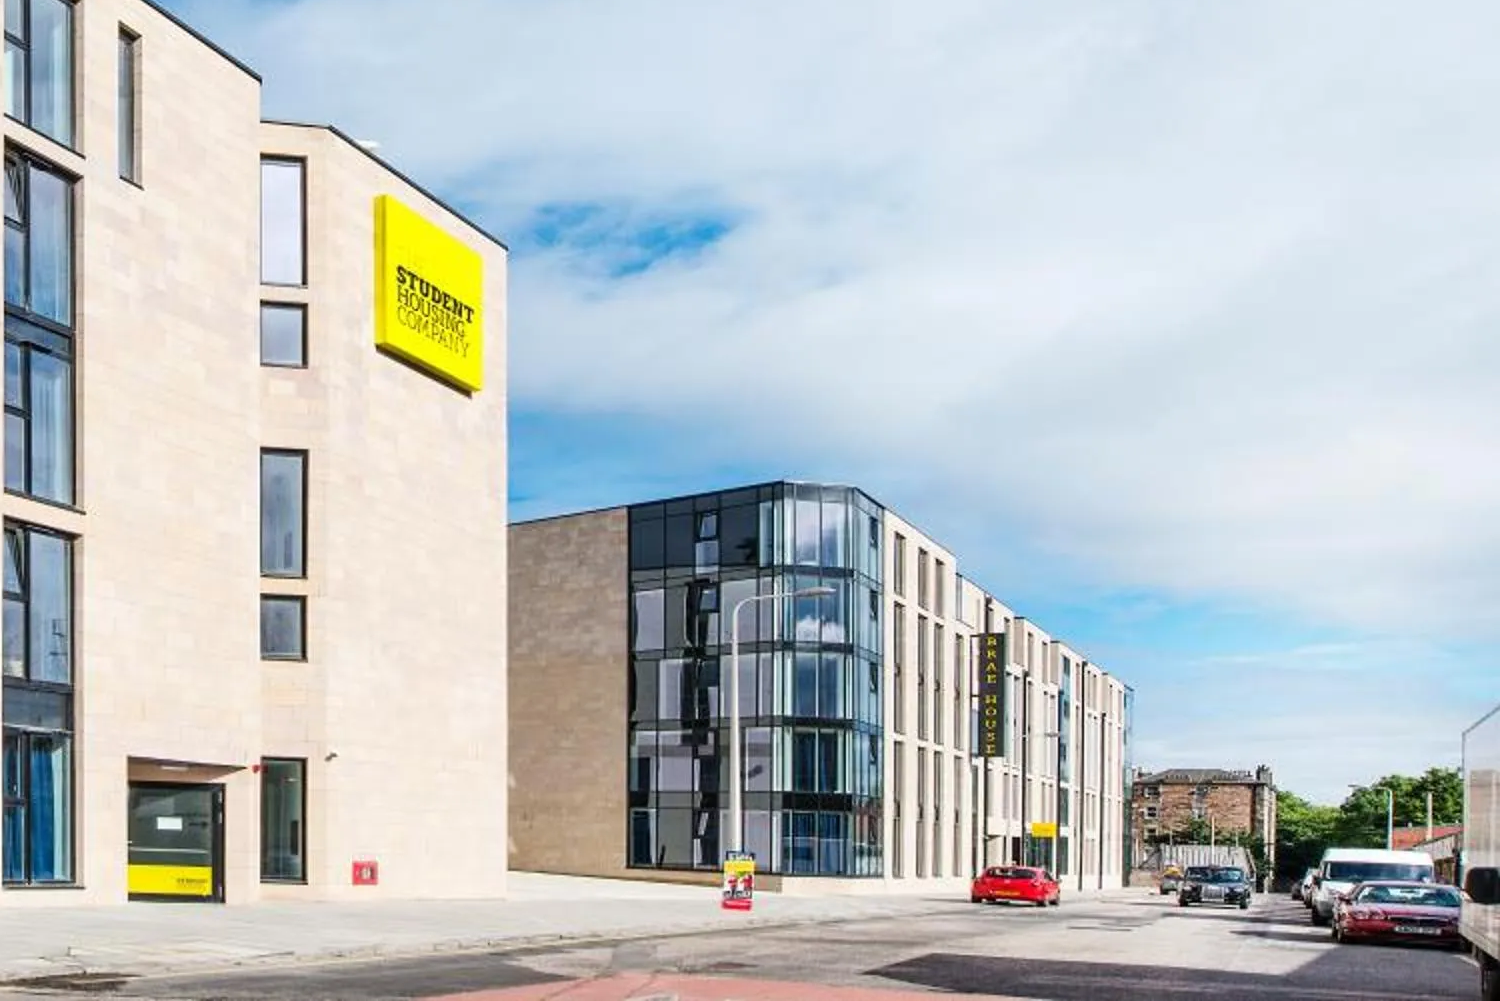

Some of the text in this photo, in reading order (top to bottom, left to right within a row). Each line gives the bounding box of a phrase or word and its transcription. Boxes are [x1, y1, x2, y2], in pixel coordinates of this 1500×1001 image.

[396, 264, 475, 324] STUDENT
[397, 284, 466, 338] HOUSING
[397, 305, 470, 358] COMPANY
[984, 635, 997, 754] BRAE HOUSE
